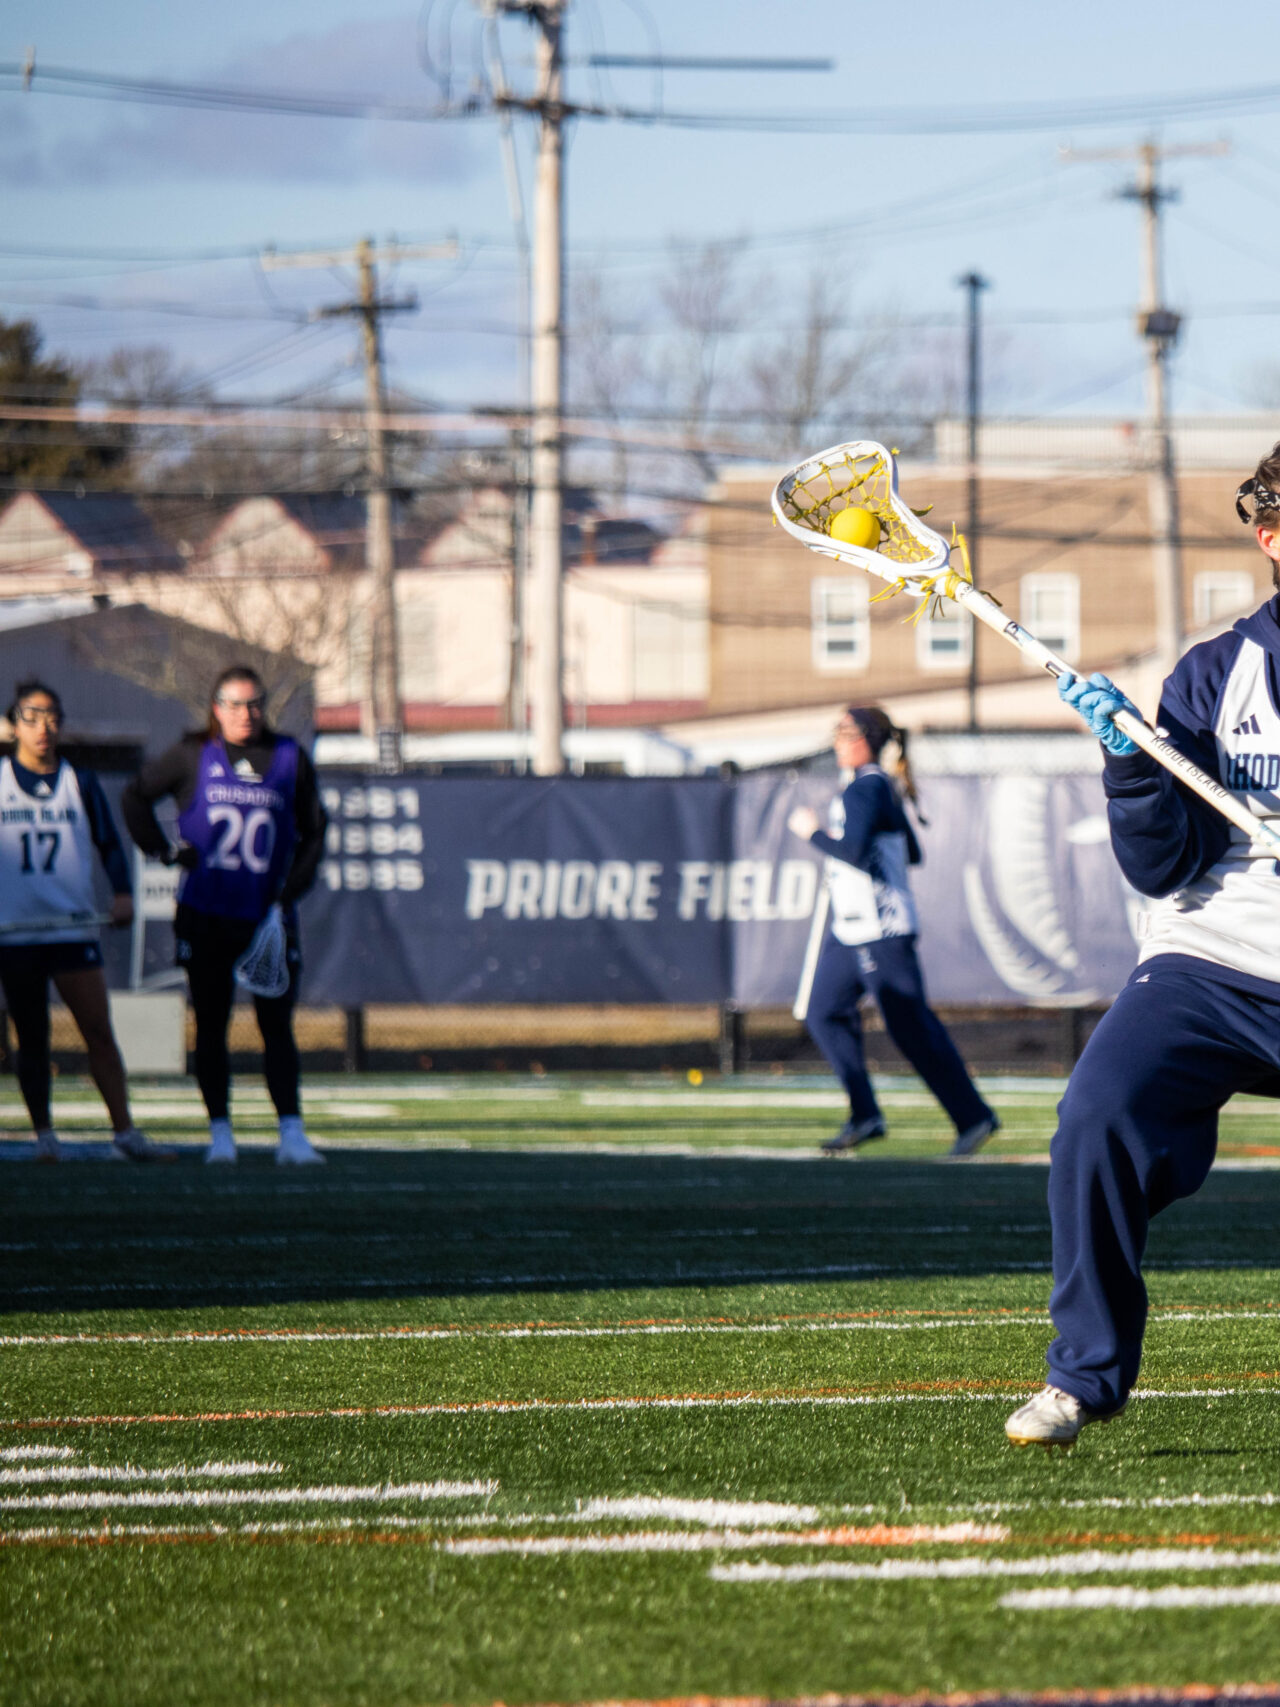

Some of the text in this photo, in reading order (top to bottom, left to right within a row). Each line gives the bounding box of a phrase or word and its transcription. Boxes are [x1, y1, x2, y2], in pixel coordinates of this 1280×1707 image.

[1187, 765, 1229, 799] ISLAND
[20, 831, 61, 874] 17
[206, 803, 276, 874] 20
[465, 858, 817, 922] PRIORE FIELD
